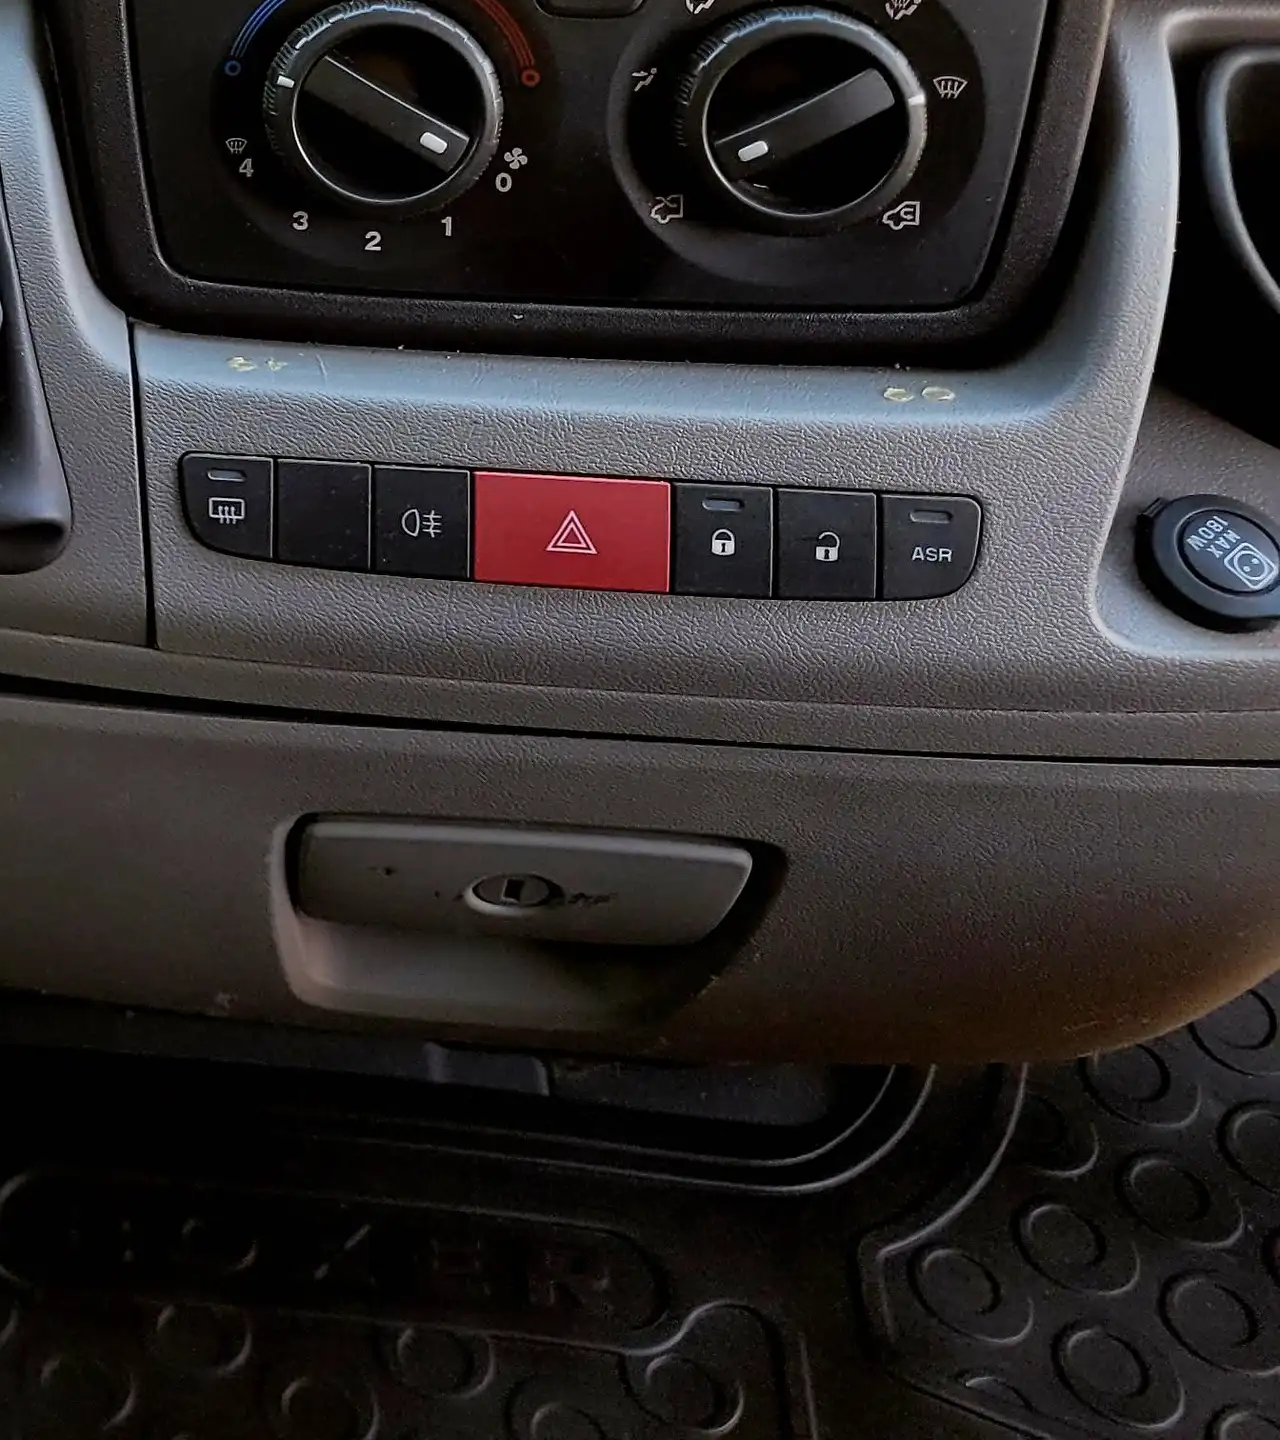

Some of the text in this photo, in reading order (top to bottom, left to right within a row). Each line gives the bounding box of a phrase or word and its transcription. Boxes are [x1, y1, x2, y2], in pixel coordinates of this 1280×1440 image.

[239, 158, 254, 177] 4
[495, 172, 513, 193] 0
[292, 210, 309, 231] 3
[441, 216, 453, 236] 1
[364, 231, 382, 251] 2
[1186, 515, 1229, 551] 180W
[912, 546, 952, 562] ASR
[1206, 529, 1242, 559] MAX
